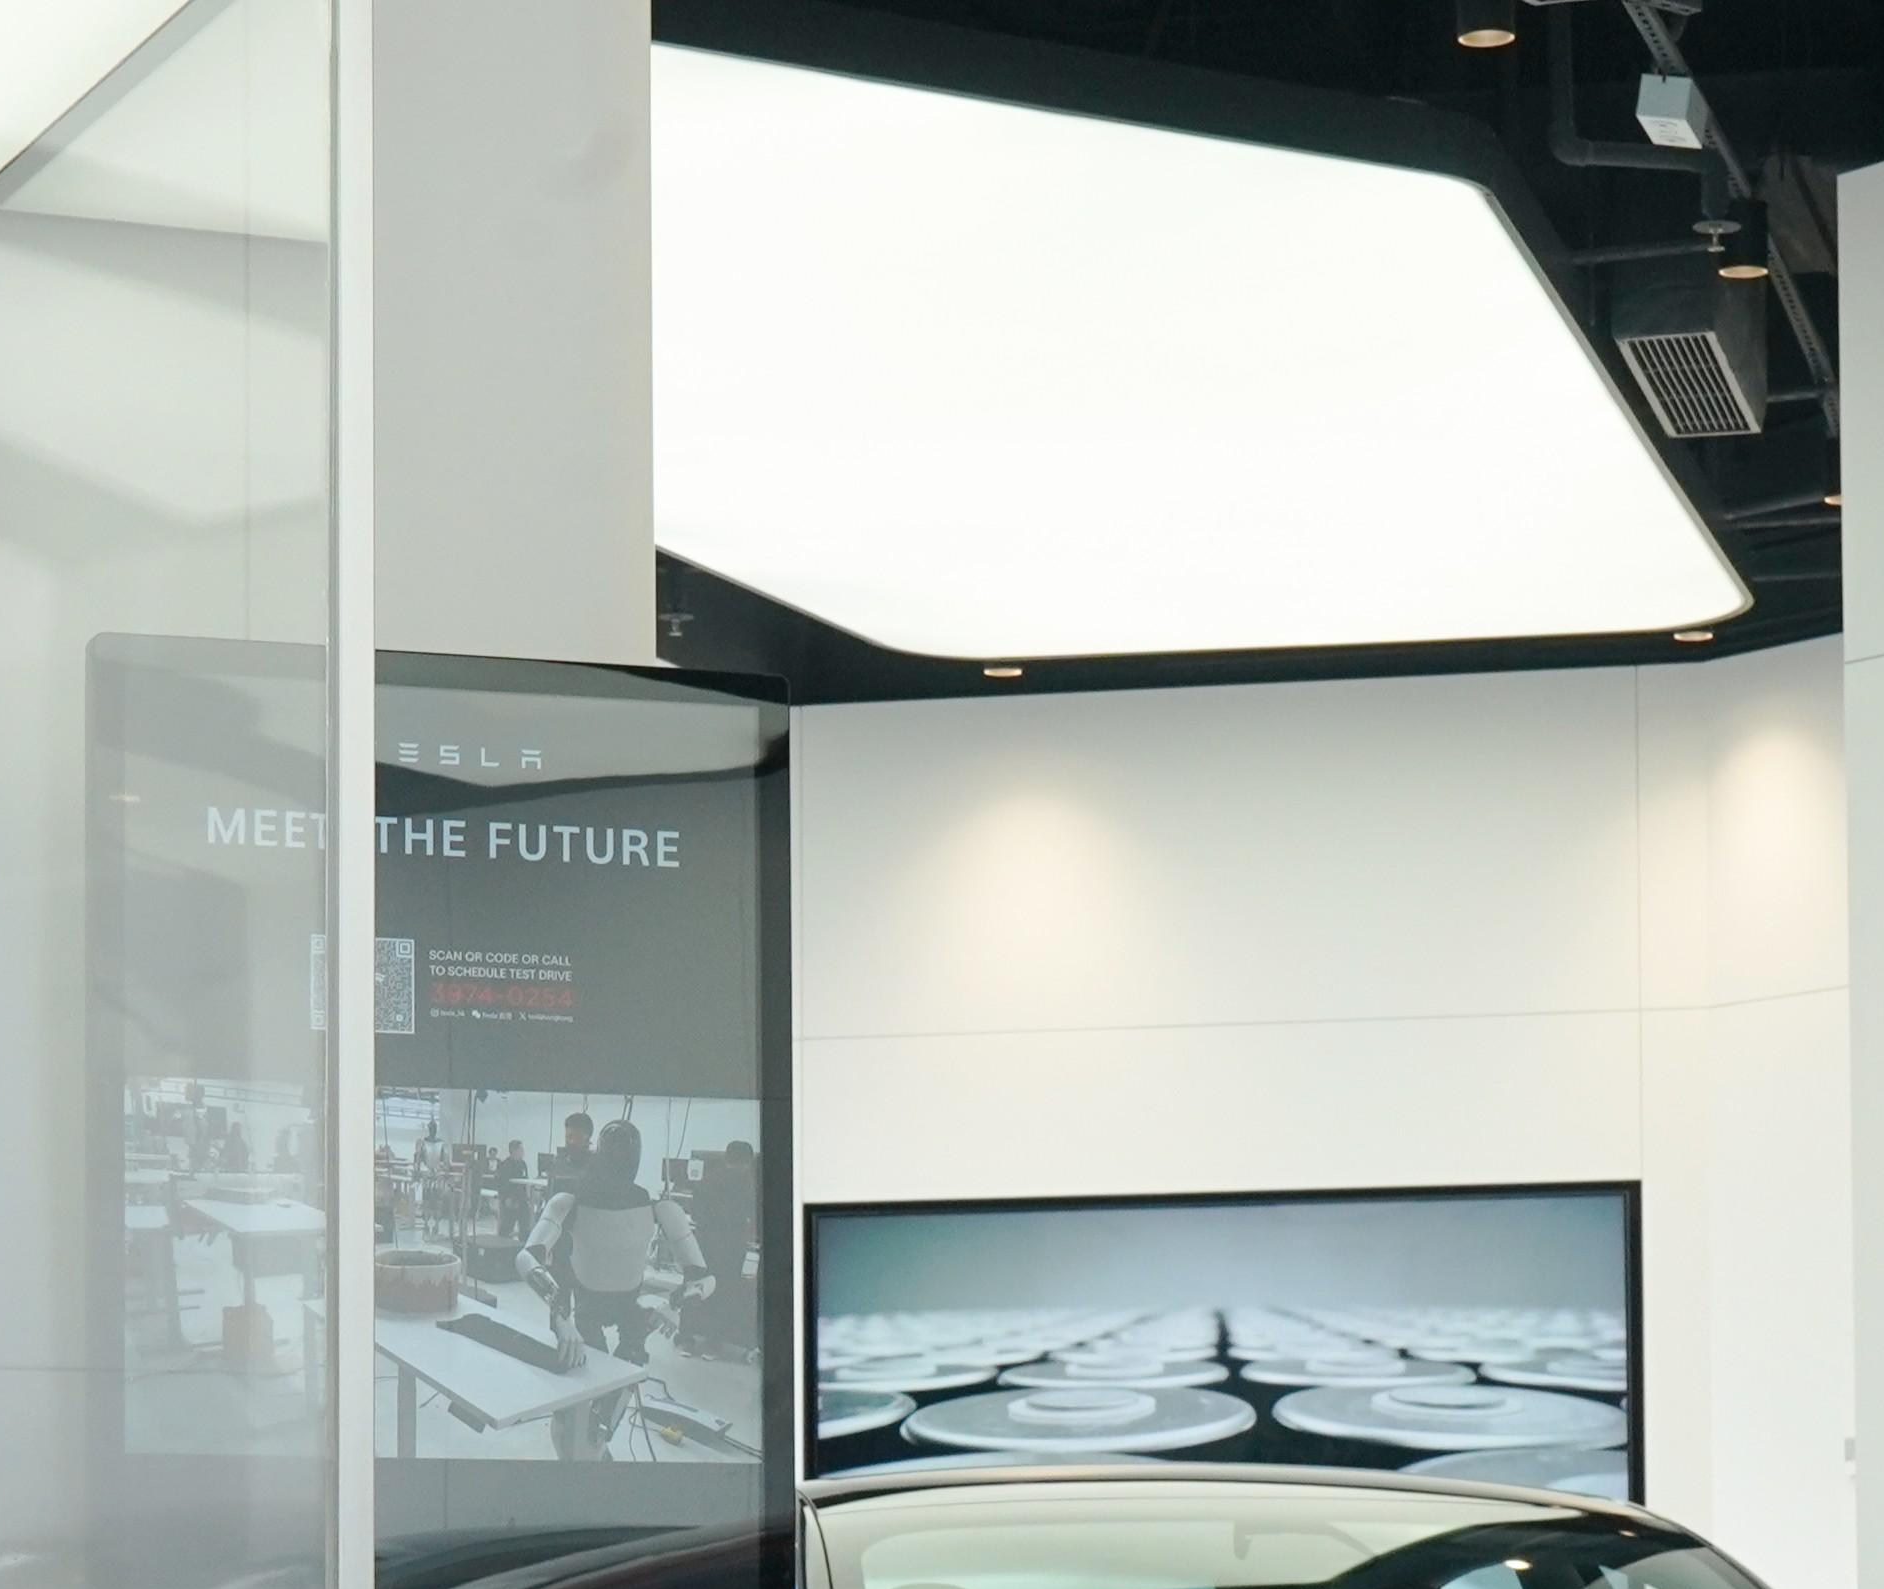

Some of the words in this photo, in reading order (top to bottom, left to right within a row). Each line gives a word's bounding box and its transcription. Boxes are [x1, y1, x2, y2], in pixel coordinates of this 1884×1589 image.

[397, 742, 542, 770] ESLA
[206, 806, 325, 850] MEET
[375, 815, 467, 858] THE
[488, 821, 683, 868] FUTURE
[429, 950, 462, 961] SCAN
[465, 951, 482, 962] QR
[486, 952, 518, 964] CODE
[521, 954, 539, 965] OR
[542, 955, 571, 966] CALL
[429, 965, 446, 976] TO
[448, 966, 506, 979] SCHEDULE
[509, 968, 536, 980] TEST
[539, 969, 573, 982] DRIVE
